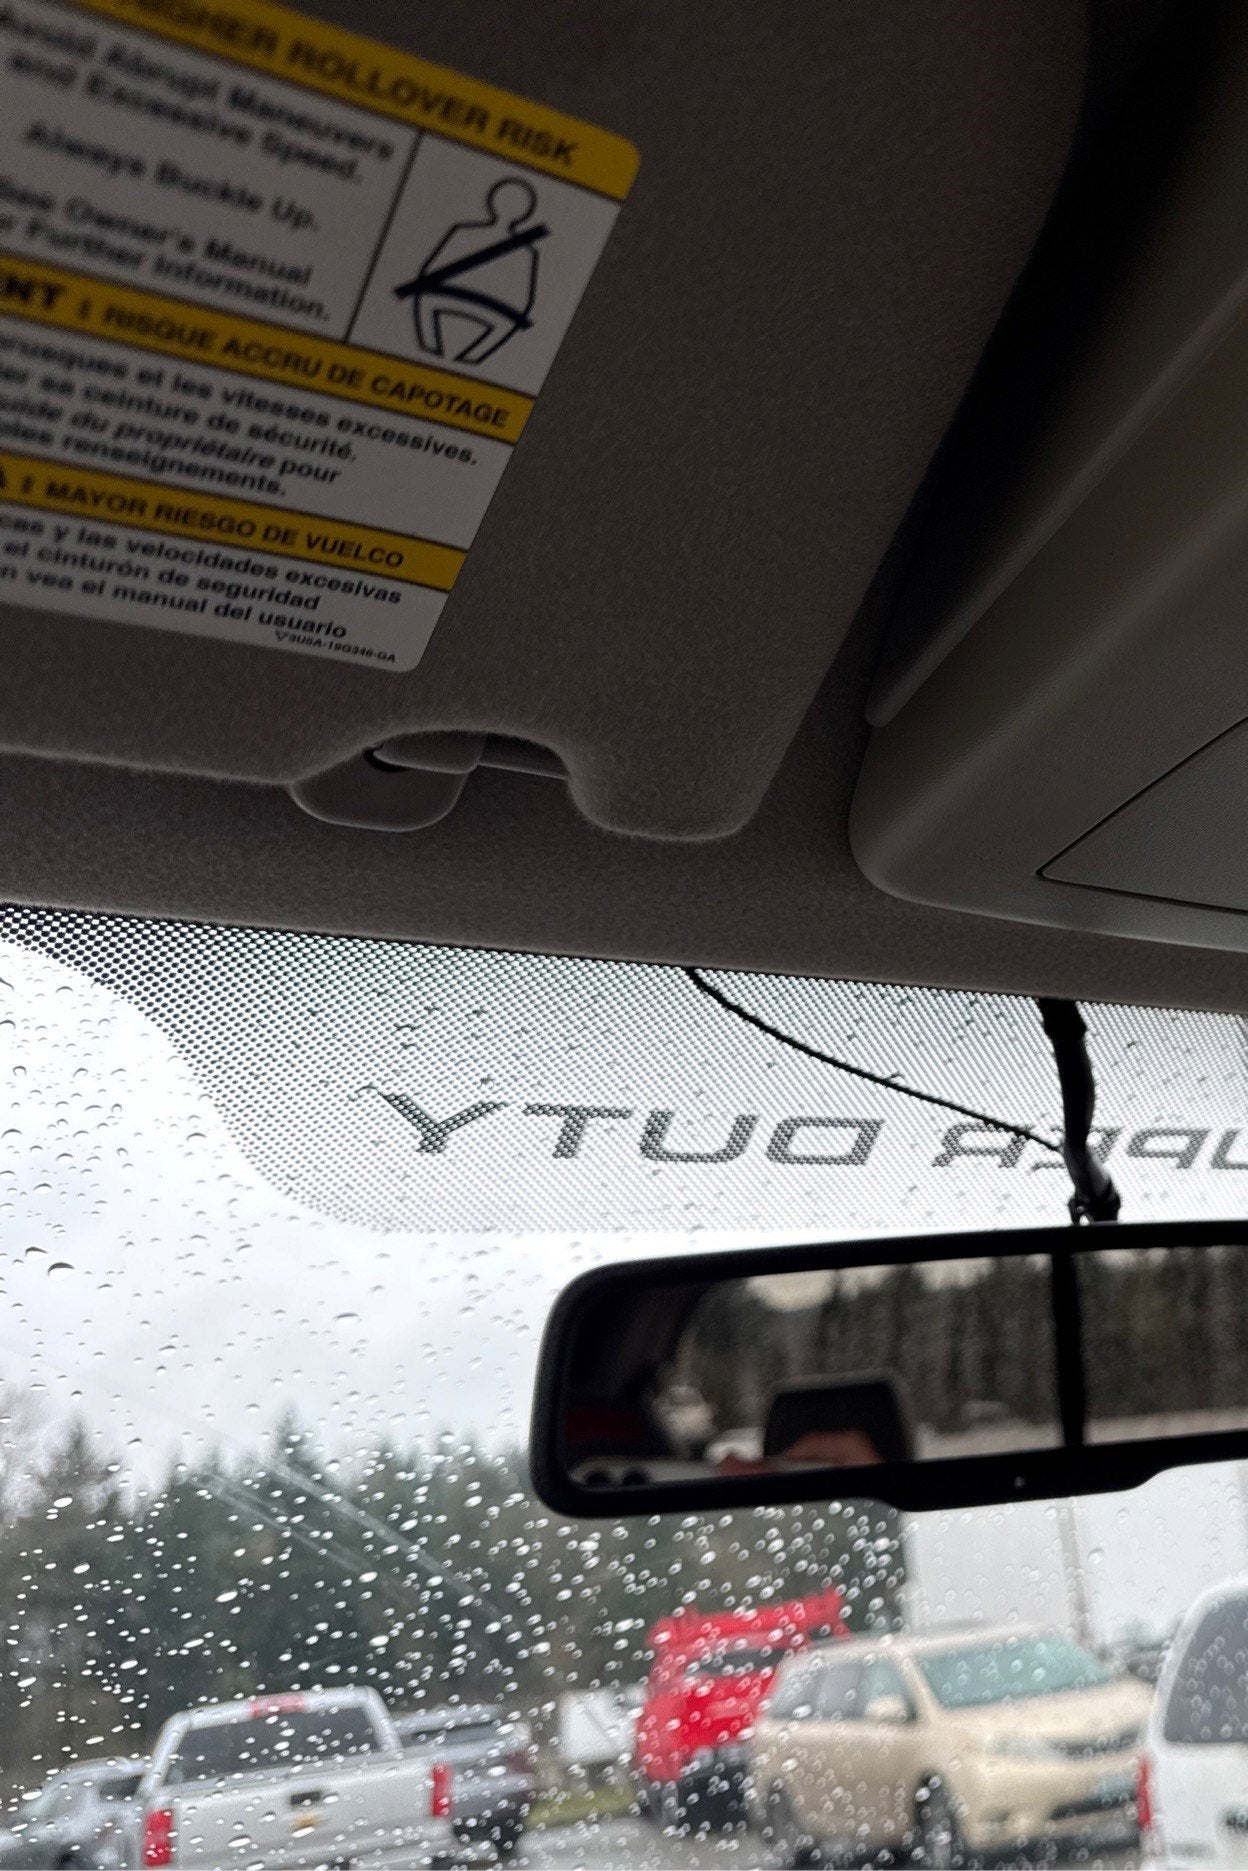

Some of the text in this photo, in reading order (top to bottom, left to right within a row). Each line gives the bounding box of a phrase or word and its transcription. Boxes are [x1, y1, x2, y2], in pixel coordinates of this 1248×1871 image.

[10, 50, 362, 184] and Excessive Speed.
[105, 44, 220, 103] Abrupt
[228, 85, 392, 160] Maneuvers
[287, 39, 490, 134] ROLLOVER
[497, 117, 578, 165] RISK
[26, 120, 320, 232] Always Buckle Up.
[26, 216, 145, 272] Further
[152, 255, 330, 321] Information.
[65, 195, 197, 253] Owner's
[203, 236, 314, 285] Manual
[103, 303, 217, 350] RISQUE
[222, 337, 322, 377] ACCRU
[327, 363, 366, 388] DE
[371, 374, 511, 429] CAPOTAGE
[40, 376, 75, 397] sa
[82, 384, 199, 424] ceinture
[207, 412, 240, 434] de
[248, 422, 356, 461] sécurité.
[70, 410, 109, 433] du
[113, 422, 275, 469] propriétaire
[280, 458, 340, 484] pour
[136, 366, 163, 388] et
[172, 372, 213, 399] les
[221, 388, 330, 427] vitesses
[337, 417, 478, 465] excessives.
[62, 436, 286, 496] renseignements.
[45, 480, 149, 517] MAYOR
[153, 502, 257, 537] RIESGO
[262, 523, 299, 546] DE
[305, 532, 404, 568] VUELCO
[53, 524, 70, 543] y
[77, 527, 117, 549] las
[126, 538, 279, 579] velocidades
[285, 570, 401, 604] excesivas
[4, 541, 320, 610] el cinturón de seguridad
[27, 568, 73, 591] vea
[81, 580, 106, 596] el
[112, 584, 208, 613] manual
[214, 602, 252, 621] del
[258, 610, 348, 638] usuario
